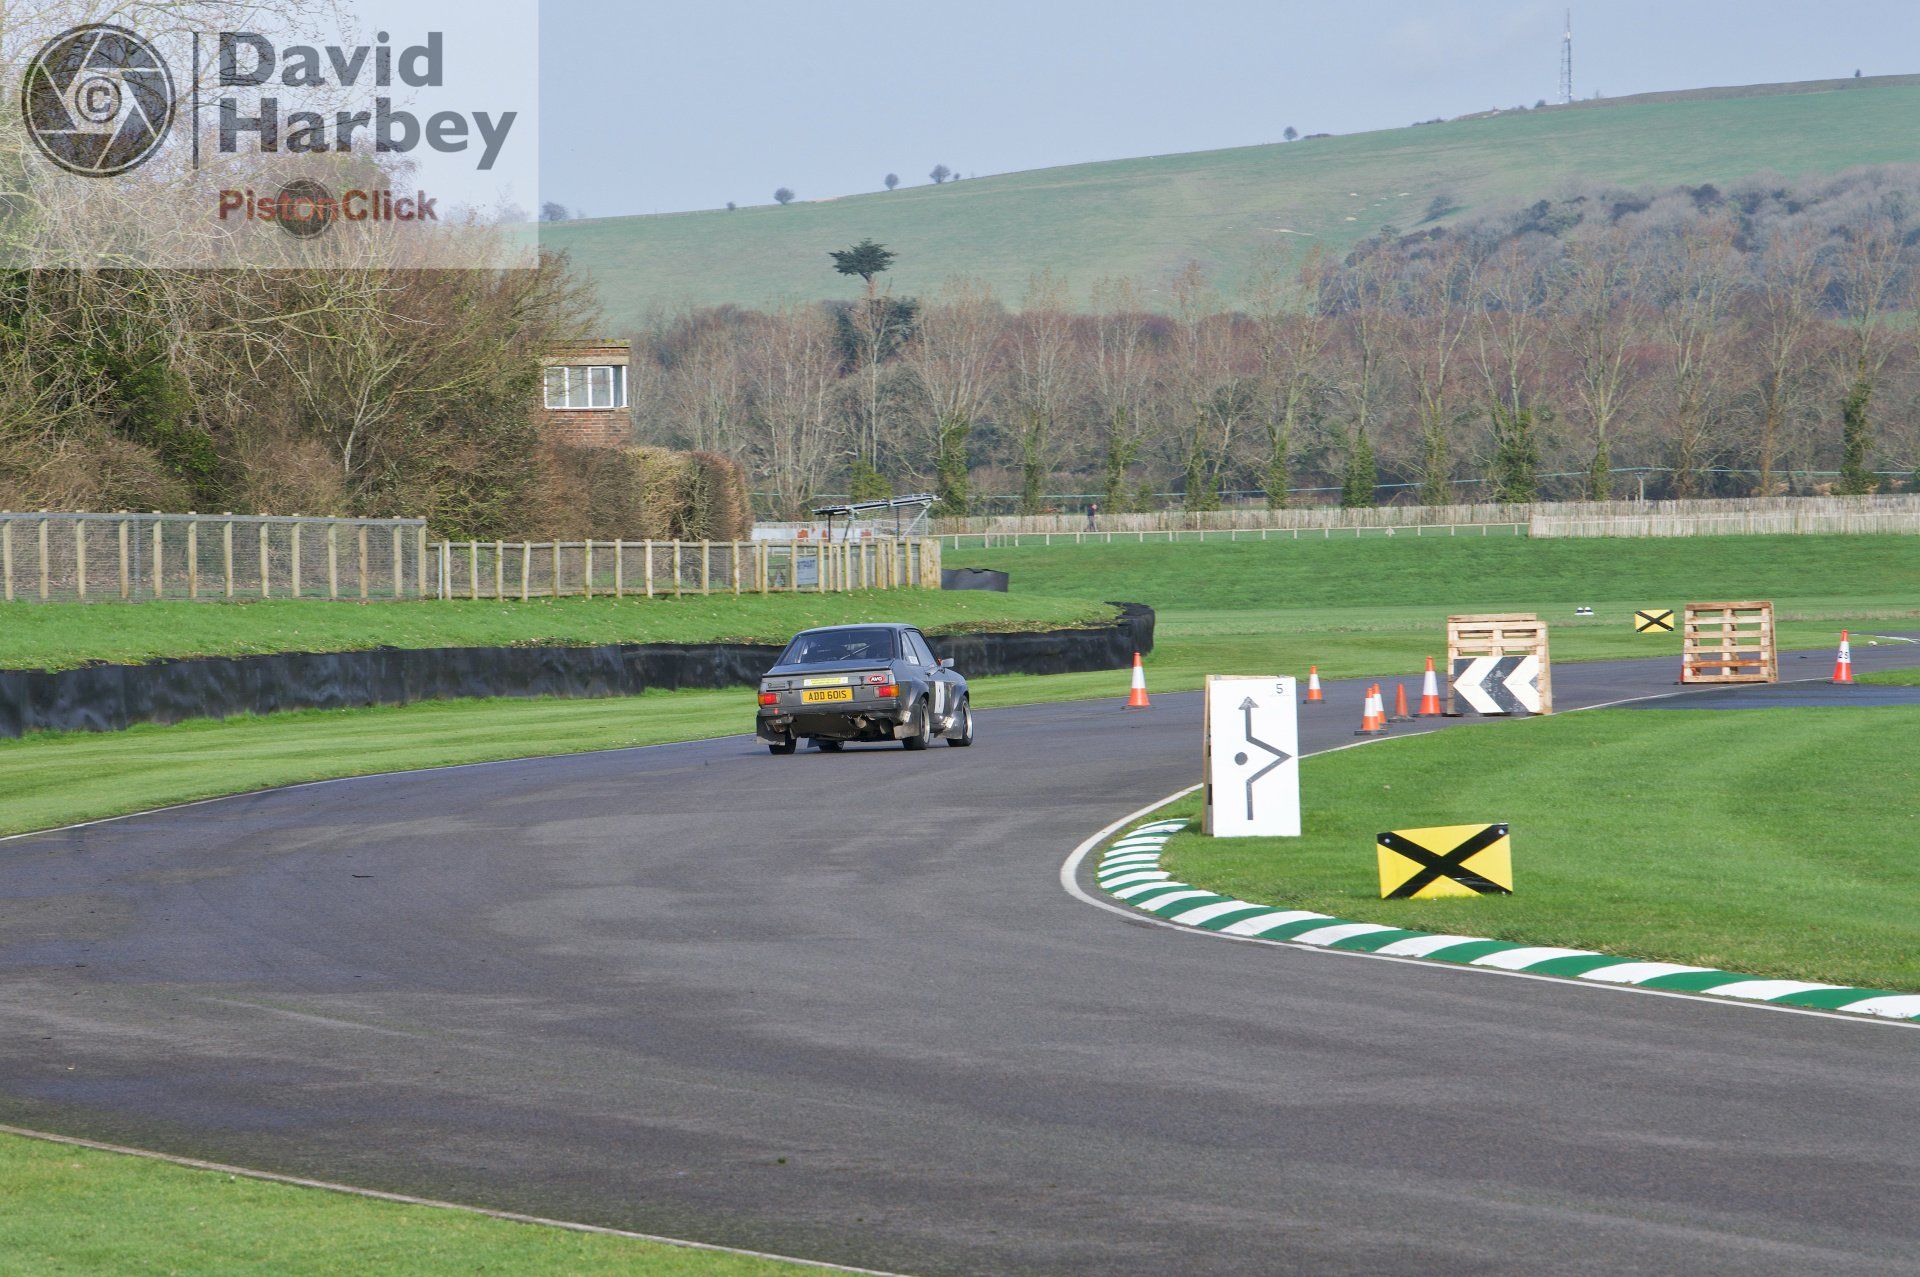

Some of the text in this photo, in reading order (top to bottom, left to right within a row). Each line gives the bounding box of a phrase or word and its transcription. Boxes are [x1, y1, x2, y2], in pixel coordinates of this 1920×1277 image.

[1276, 683, 1284, 694] 5
[808, 690, 847, 701] ADD 601S
